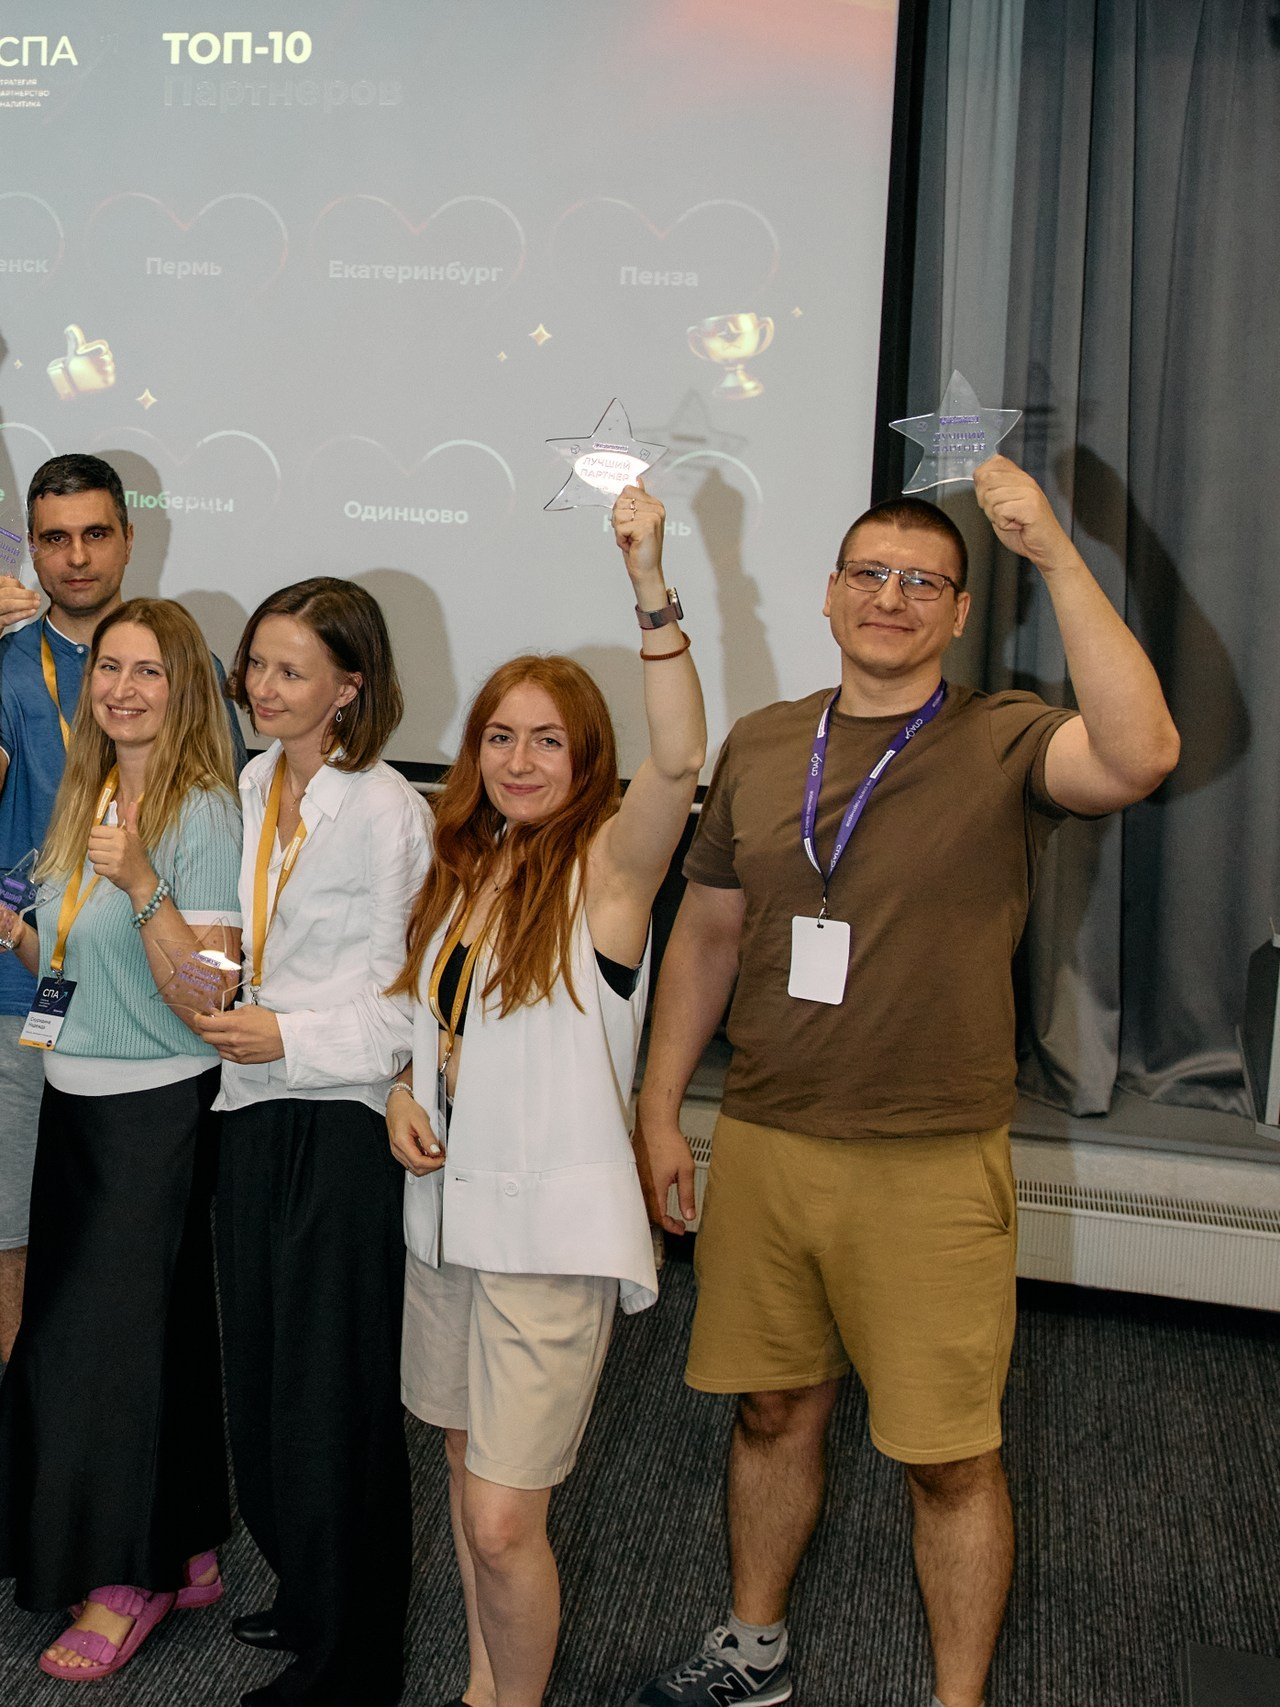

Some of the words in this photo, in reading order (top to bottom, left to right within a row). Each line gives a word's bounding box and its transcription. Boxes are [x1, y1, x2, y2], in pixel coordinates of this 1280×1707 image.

[162, 30, 313, 65] ТОП-10
[163, 75, 404, 114] Партнеров
[145, 256, 222, 276] Пермь
[327, 259, 503, 284] Екатеринбург
[620, 265, 699, 288] Пенза
[580, 468, 630, 481] ПАРТНЕР
[582, 457, 631, 470] ЛУЧШИЙ
[124, 490, 235, 514] Люберцы
[343, 500, 469, 525] Одинцово
[42, 988, 59, 999] СПА
